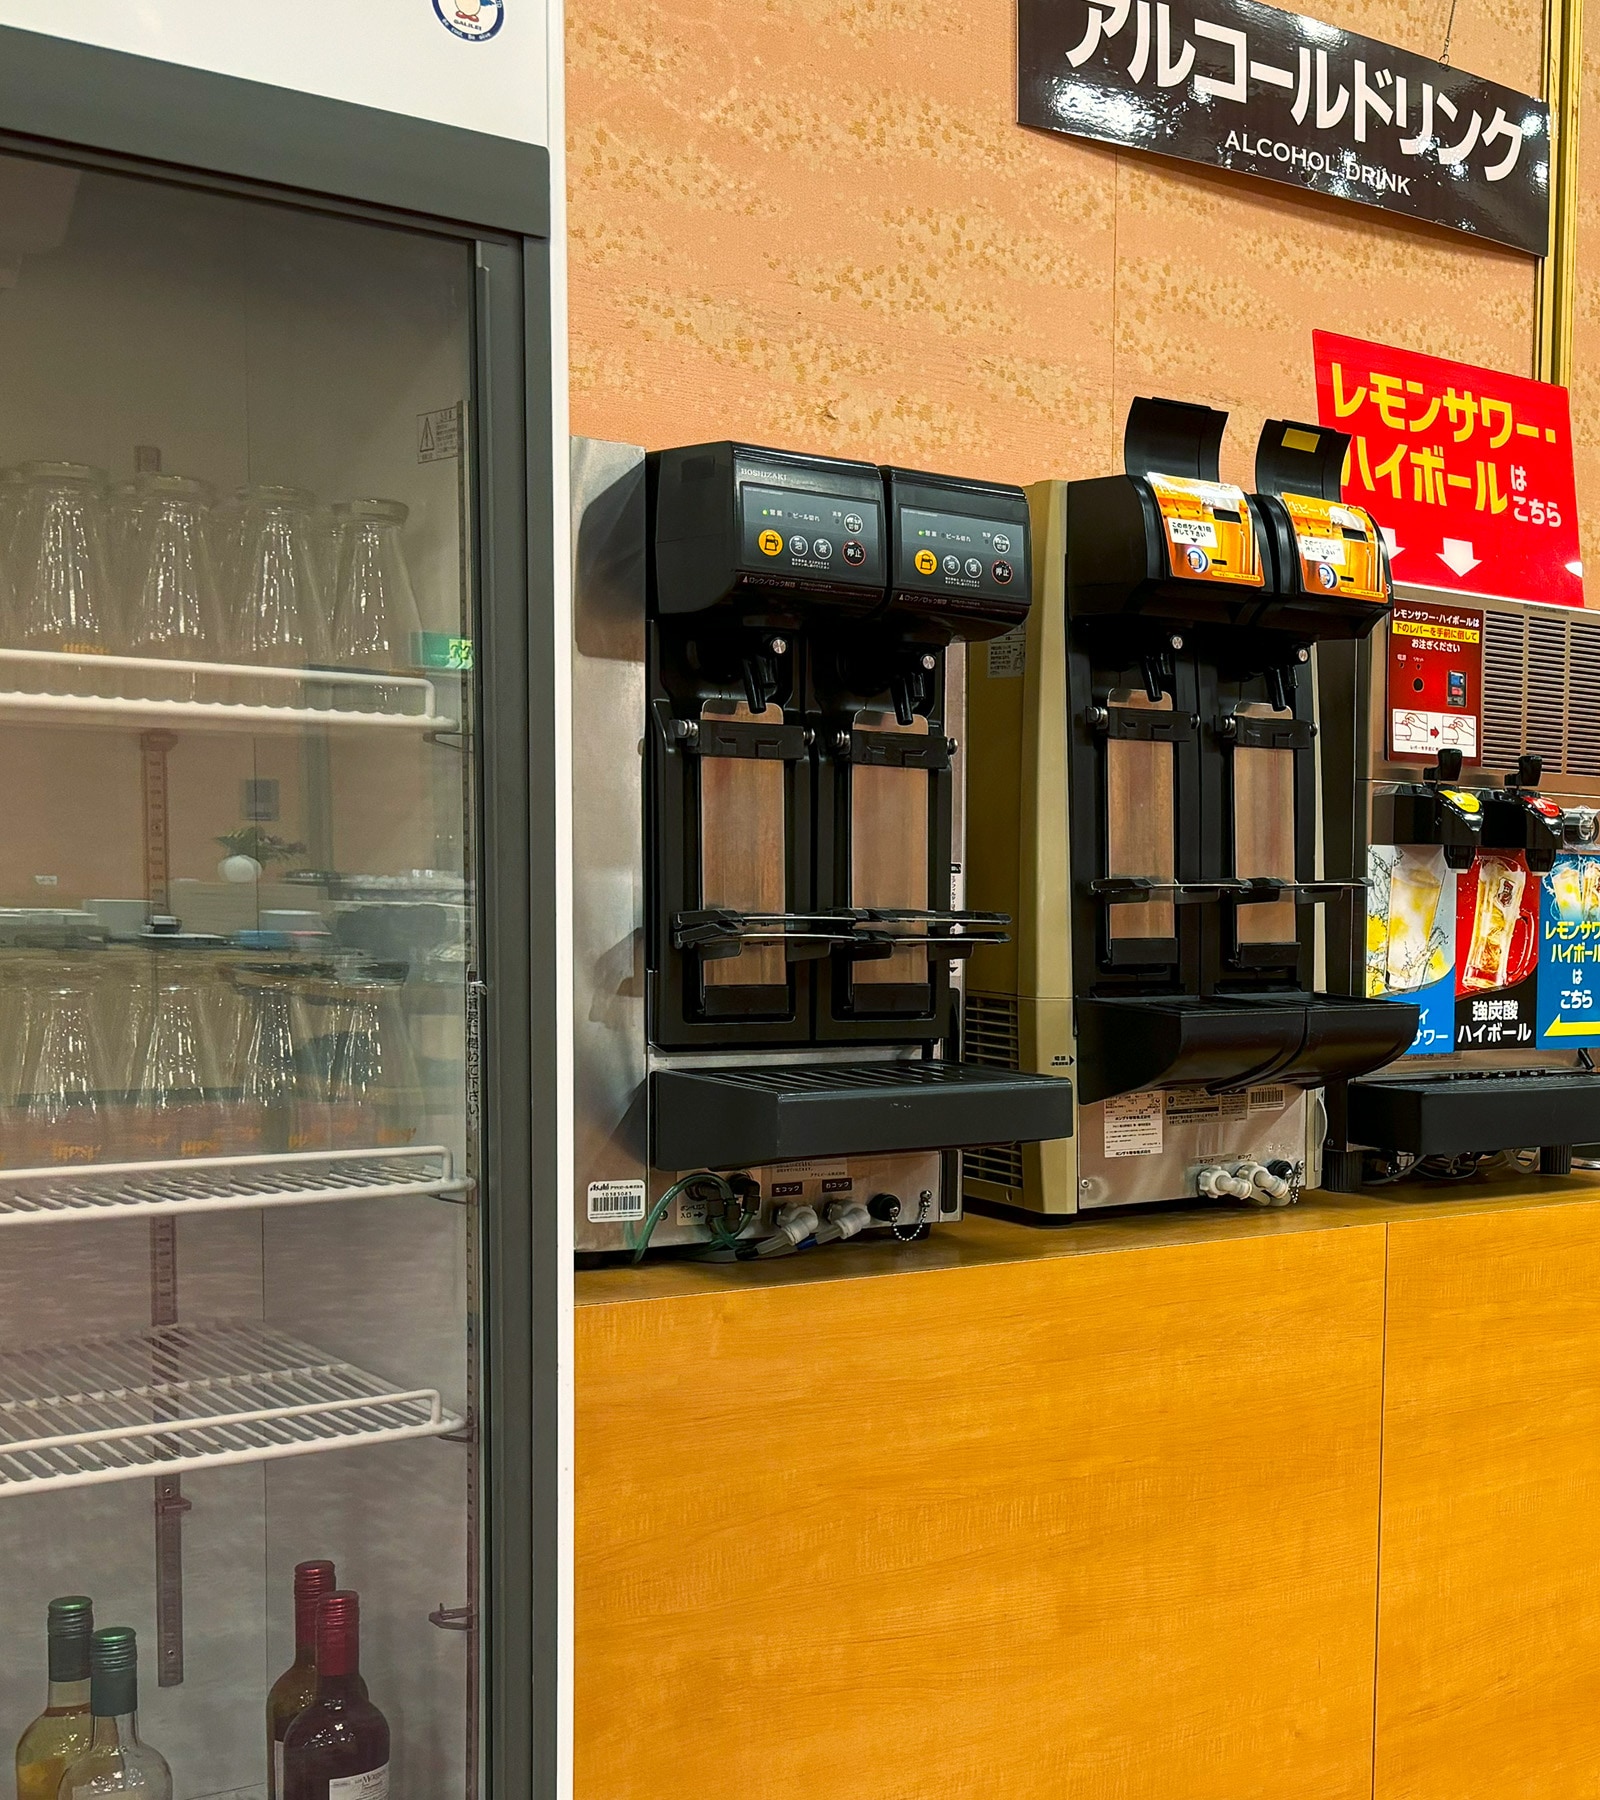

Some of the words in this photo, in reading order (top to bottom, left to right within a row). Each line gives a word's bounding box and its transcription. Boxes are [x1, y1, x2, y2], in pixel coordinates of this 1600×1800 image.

[1064, 0, 1523, 182] アルコールドリンク
[1224, 129, 1338, 176] ALCOHOL
[1343, 160, 1411, 197] DRINK
[740, 467, 787, 481] HOSHIZAKI
[1340, 434, 1508, 515] ハイボール
[1512, 495, 1562, 528] こちら
[1411, 638, 1461, 653] お注ぎください
[1571, 968, 1583, 985] は
[1559, 989, 1594, 1010] こちら
[1472, 1000, 1519, 1021] 強炭酸
[1457, 1021, 1532, 1043] ハイボール
[589, 1183, 610, 1192] Asahi
